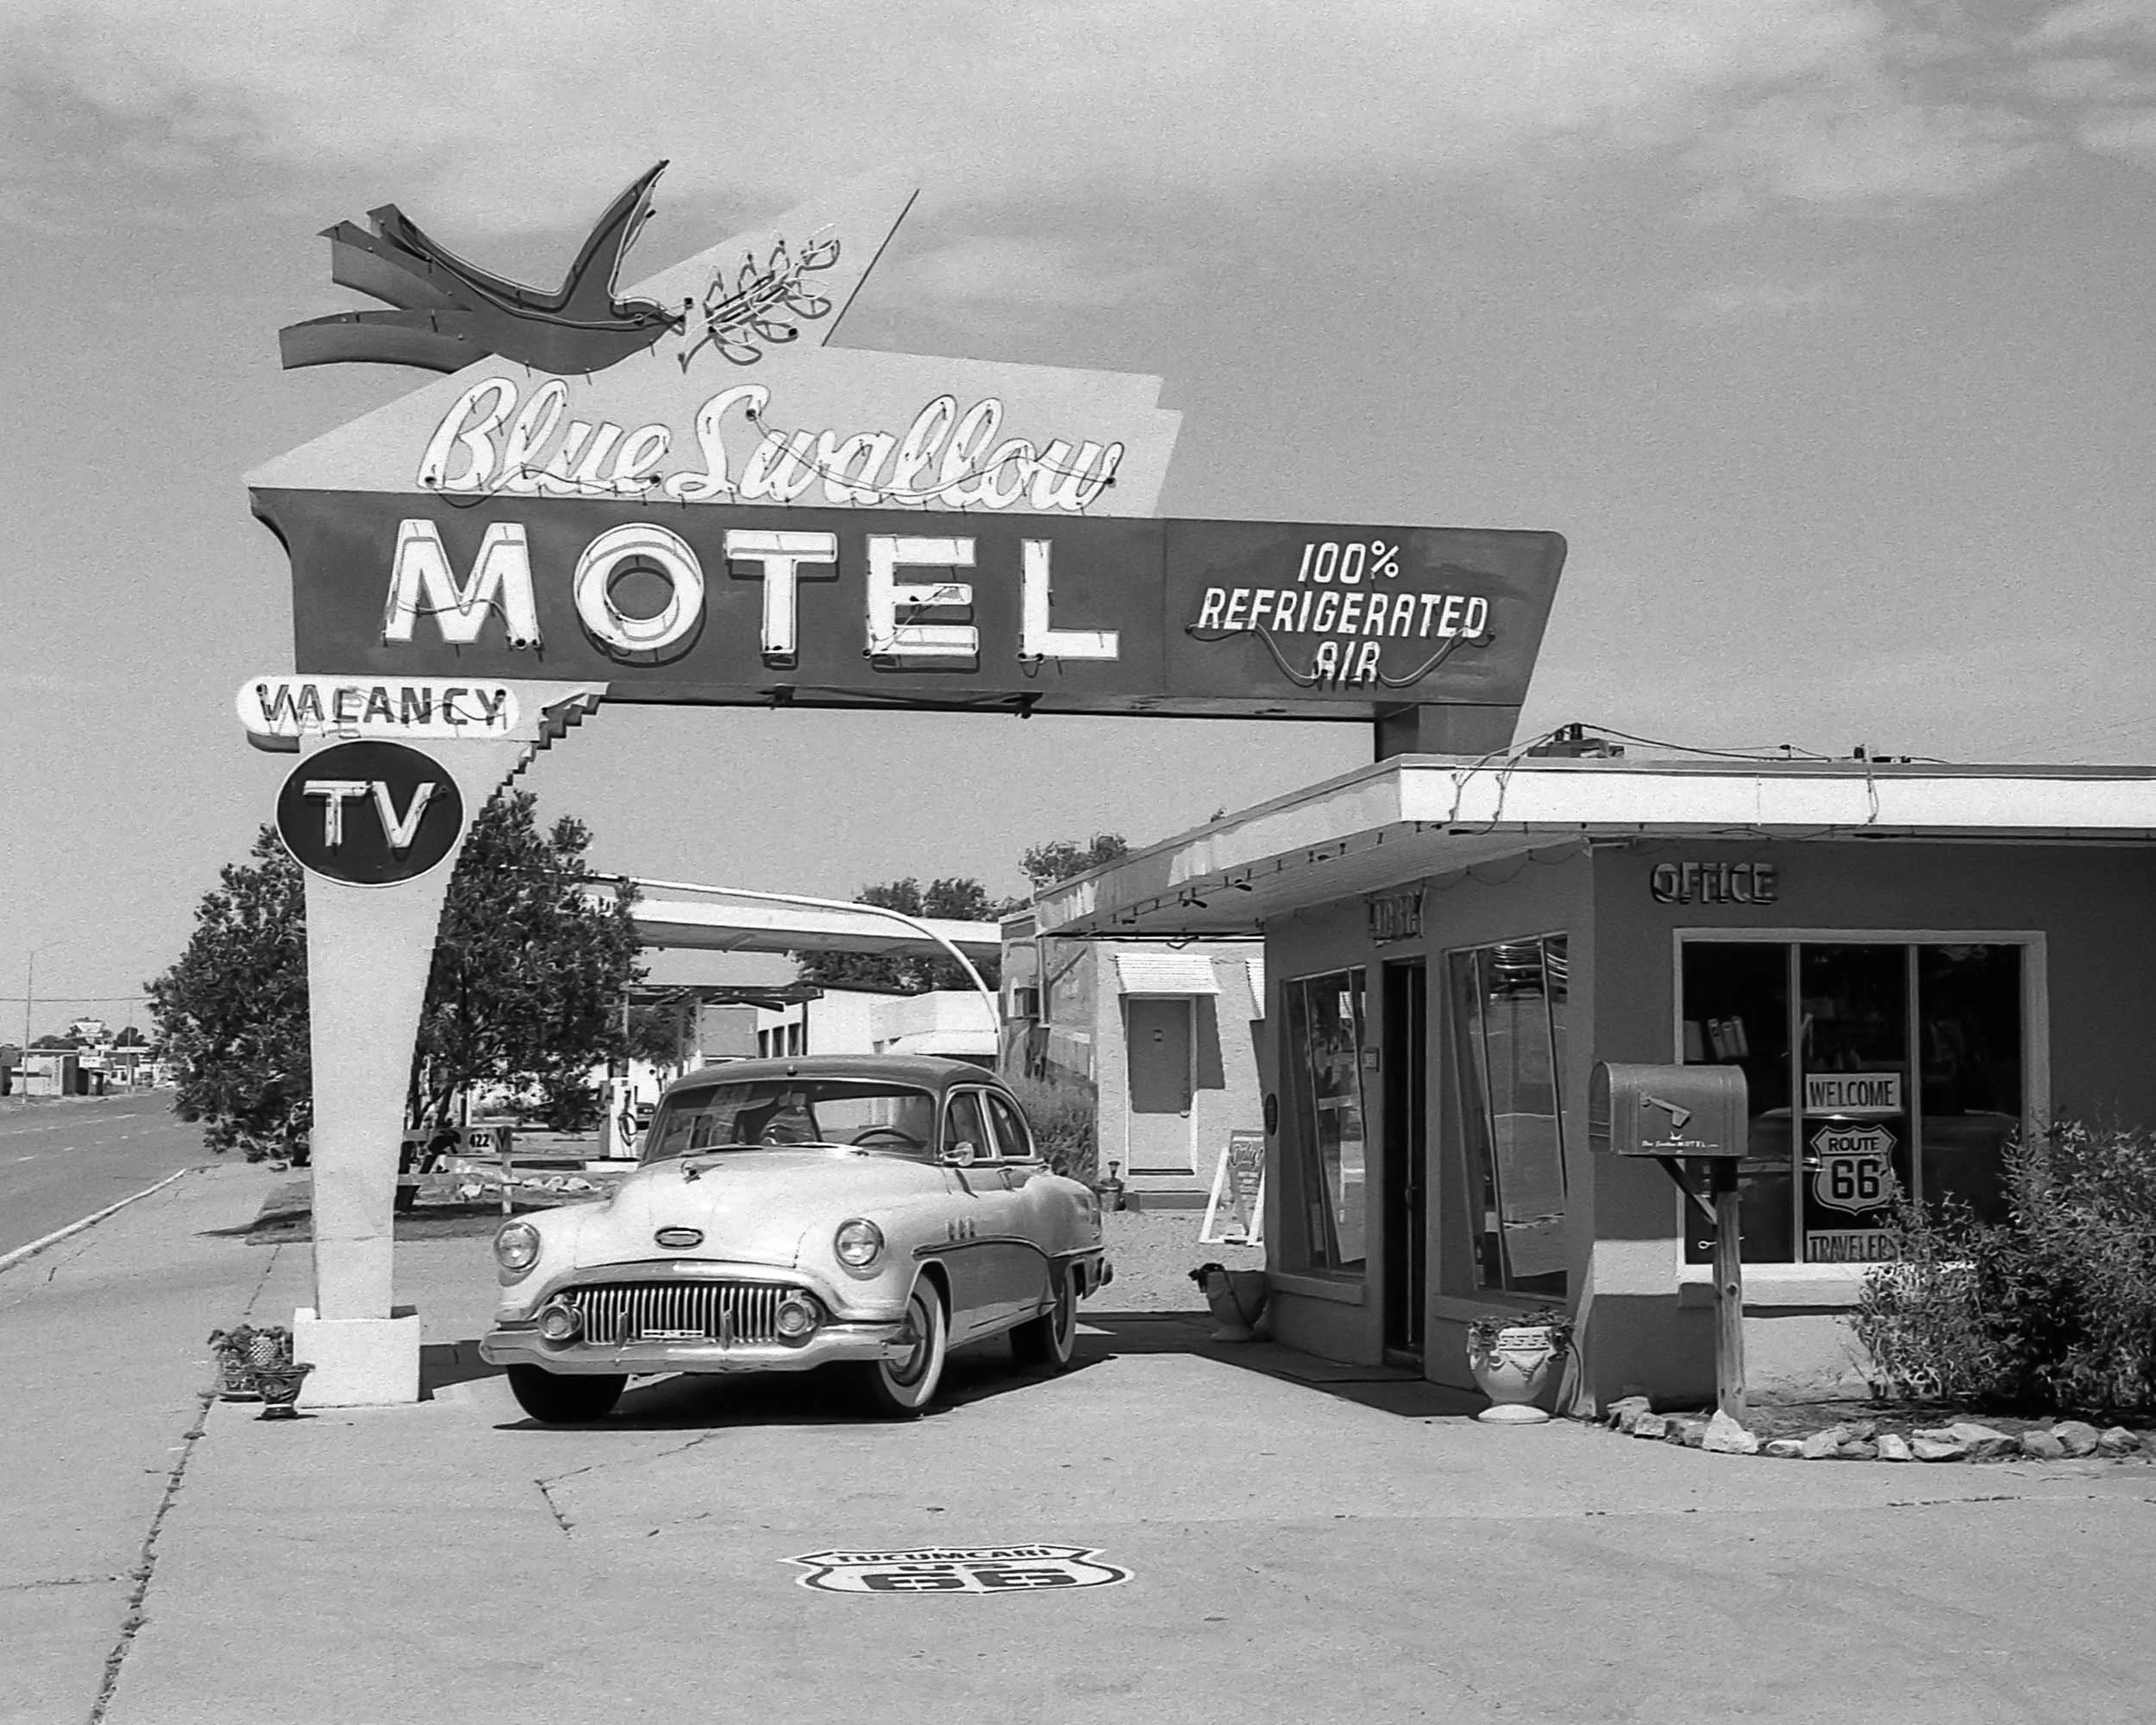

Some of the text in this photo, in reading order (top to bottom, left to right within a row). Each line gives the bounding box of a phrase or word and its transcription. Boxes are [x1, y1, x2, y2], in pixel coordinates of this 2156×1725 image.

[417, 377, 1124, 512] Blue Swallow
[1297, 540, 1400, 584] 100%
[383, 518, 1120, 661] MOTEL
[1199, 587, 1489, 638] REFRIGERATED
[1315, 641, 1381, 682] AIR
[257, 684, 507, 725] VACANCY
[303, 780, 436, 848] TV
[1651, 862, 1777, 904] OFFICE
[1811, 1081, 1894, 1107] WELCOME
[1828, 1137, 1880, 1151] ROUTE
[1832, 1158, 1880, 1200] 66
[835, 1550, 1051, 1564] TUCUMCARI
[862, 1569, 1078, 1590] 66
